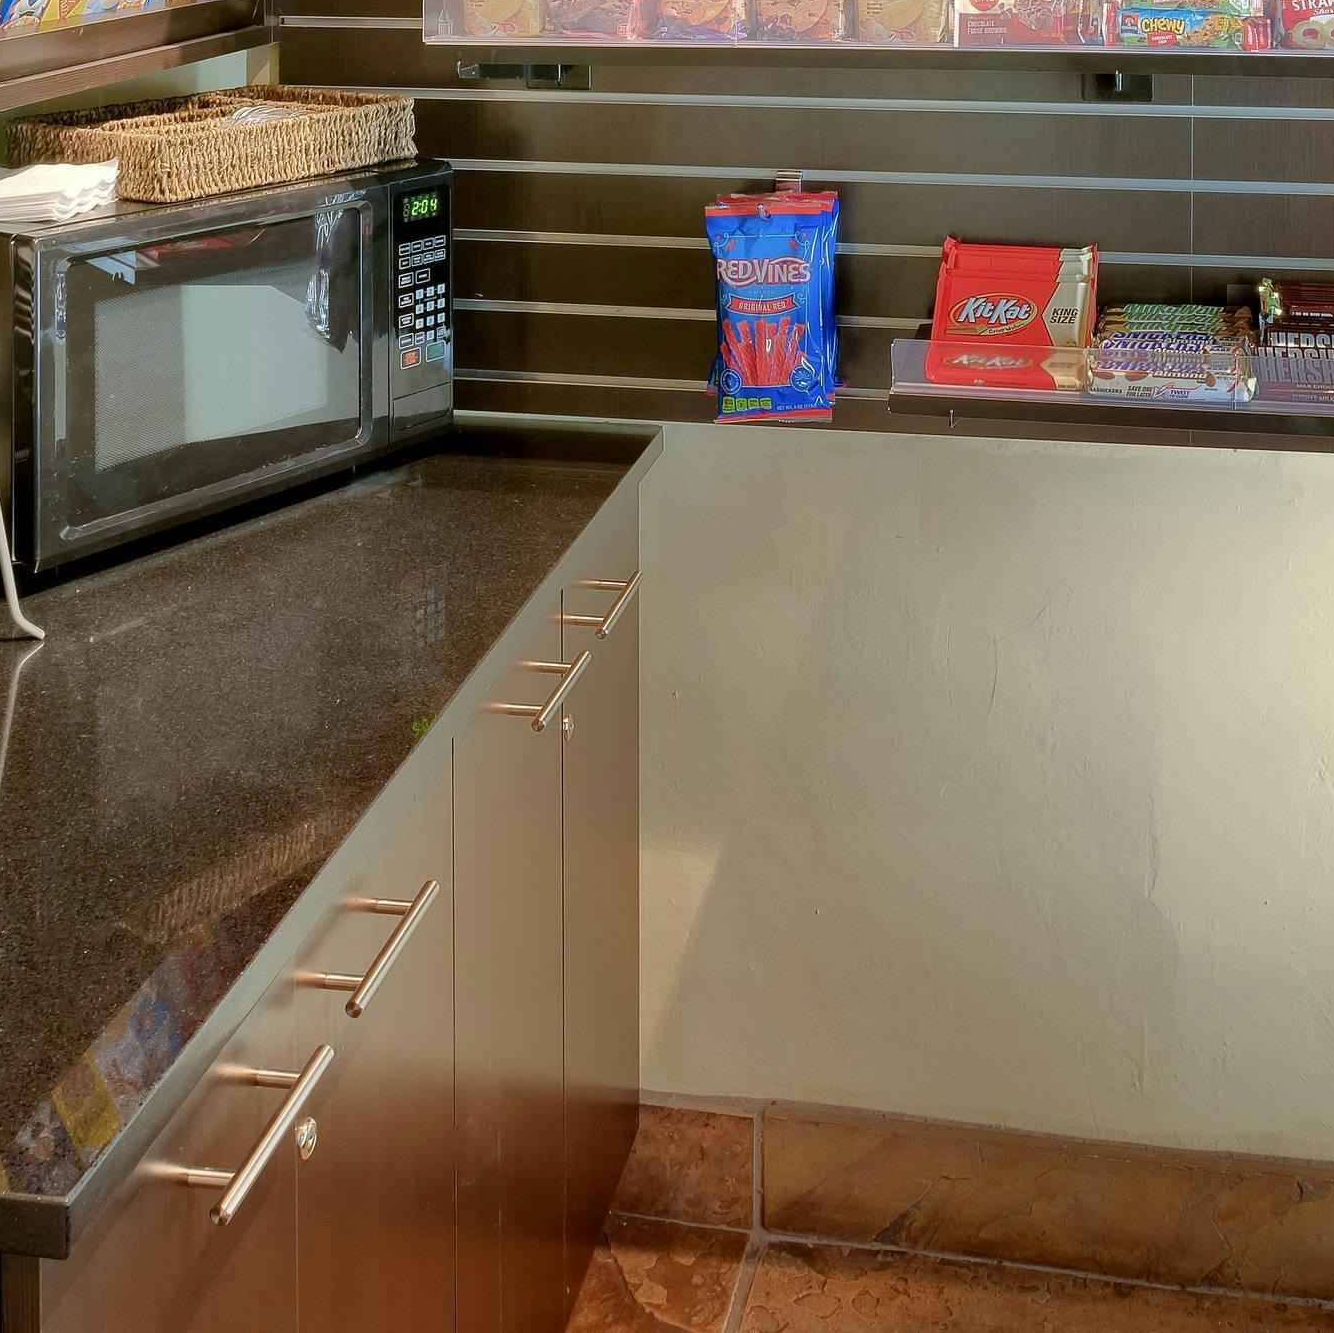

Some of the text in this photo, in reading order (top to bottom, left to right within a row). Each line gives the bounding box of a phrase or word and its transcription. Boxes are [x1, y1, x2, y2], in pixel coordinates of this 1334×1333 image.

[967, 19, 995, 27] CHOCOLATE
[1141, 17, 1187, 34] CHEWY
[411, 198, 438, 216] 2:04
[772, 301, 786, 310] RED
[1051, 307, 1078, 317] KING
[1049, 315, 1077, 324] SIZE
